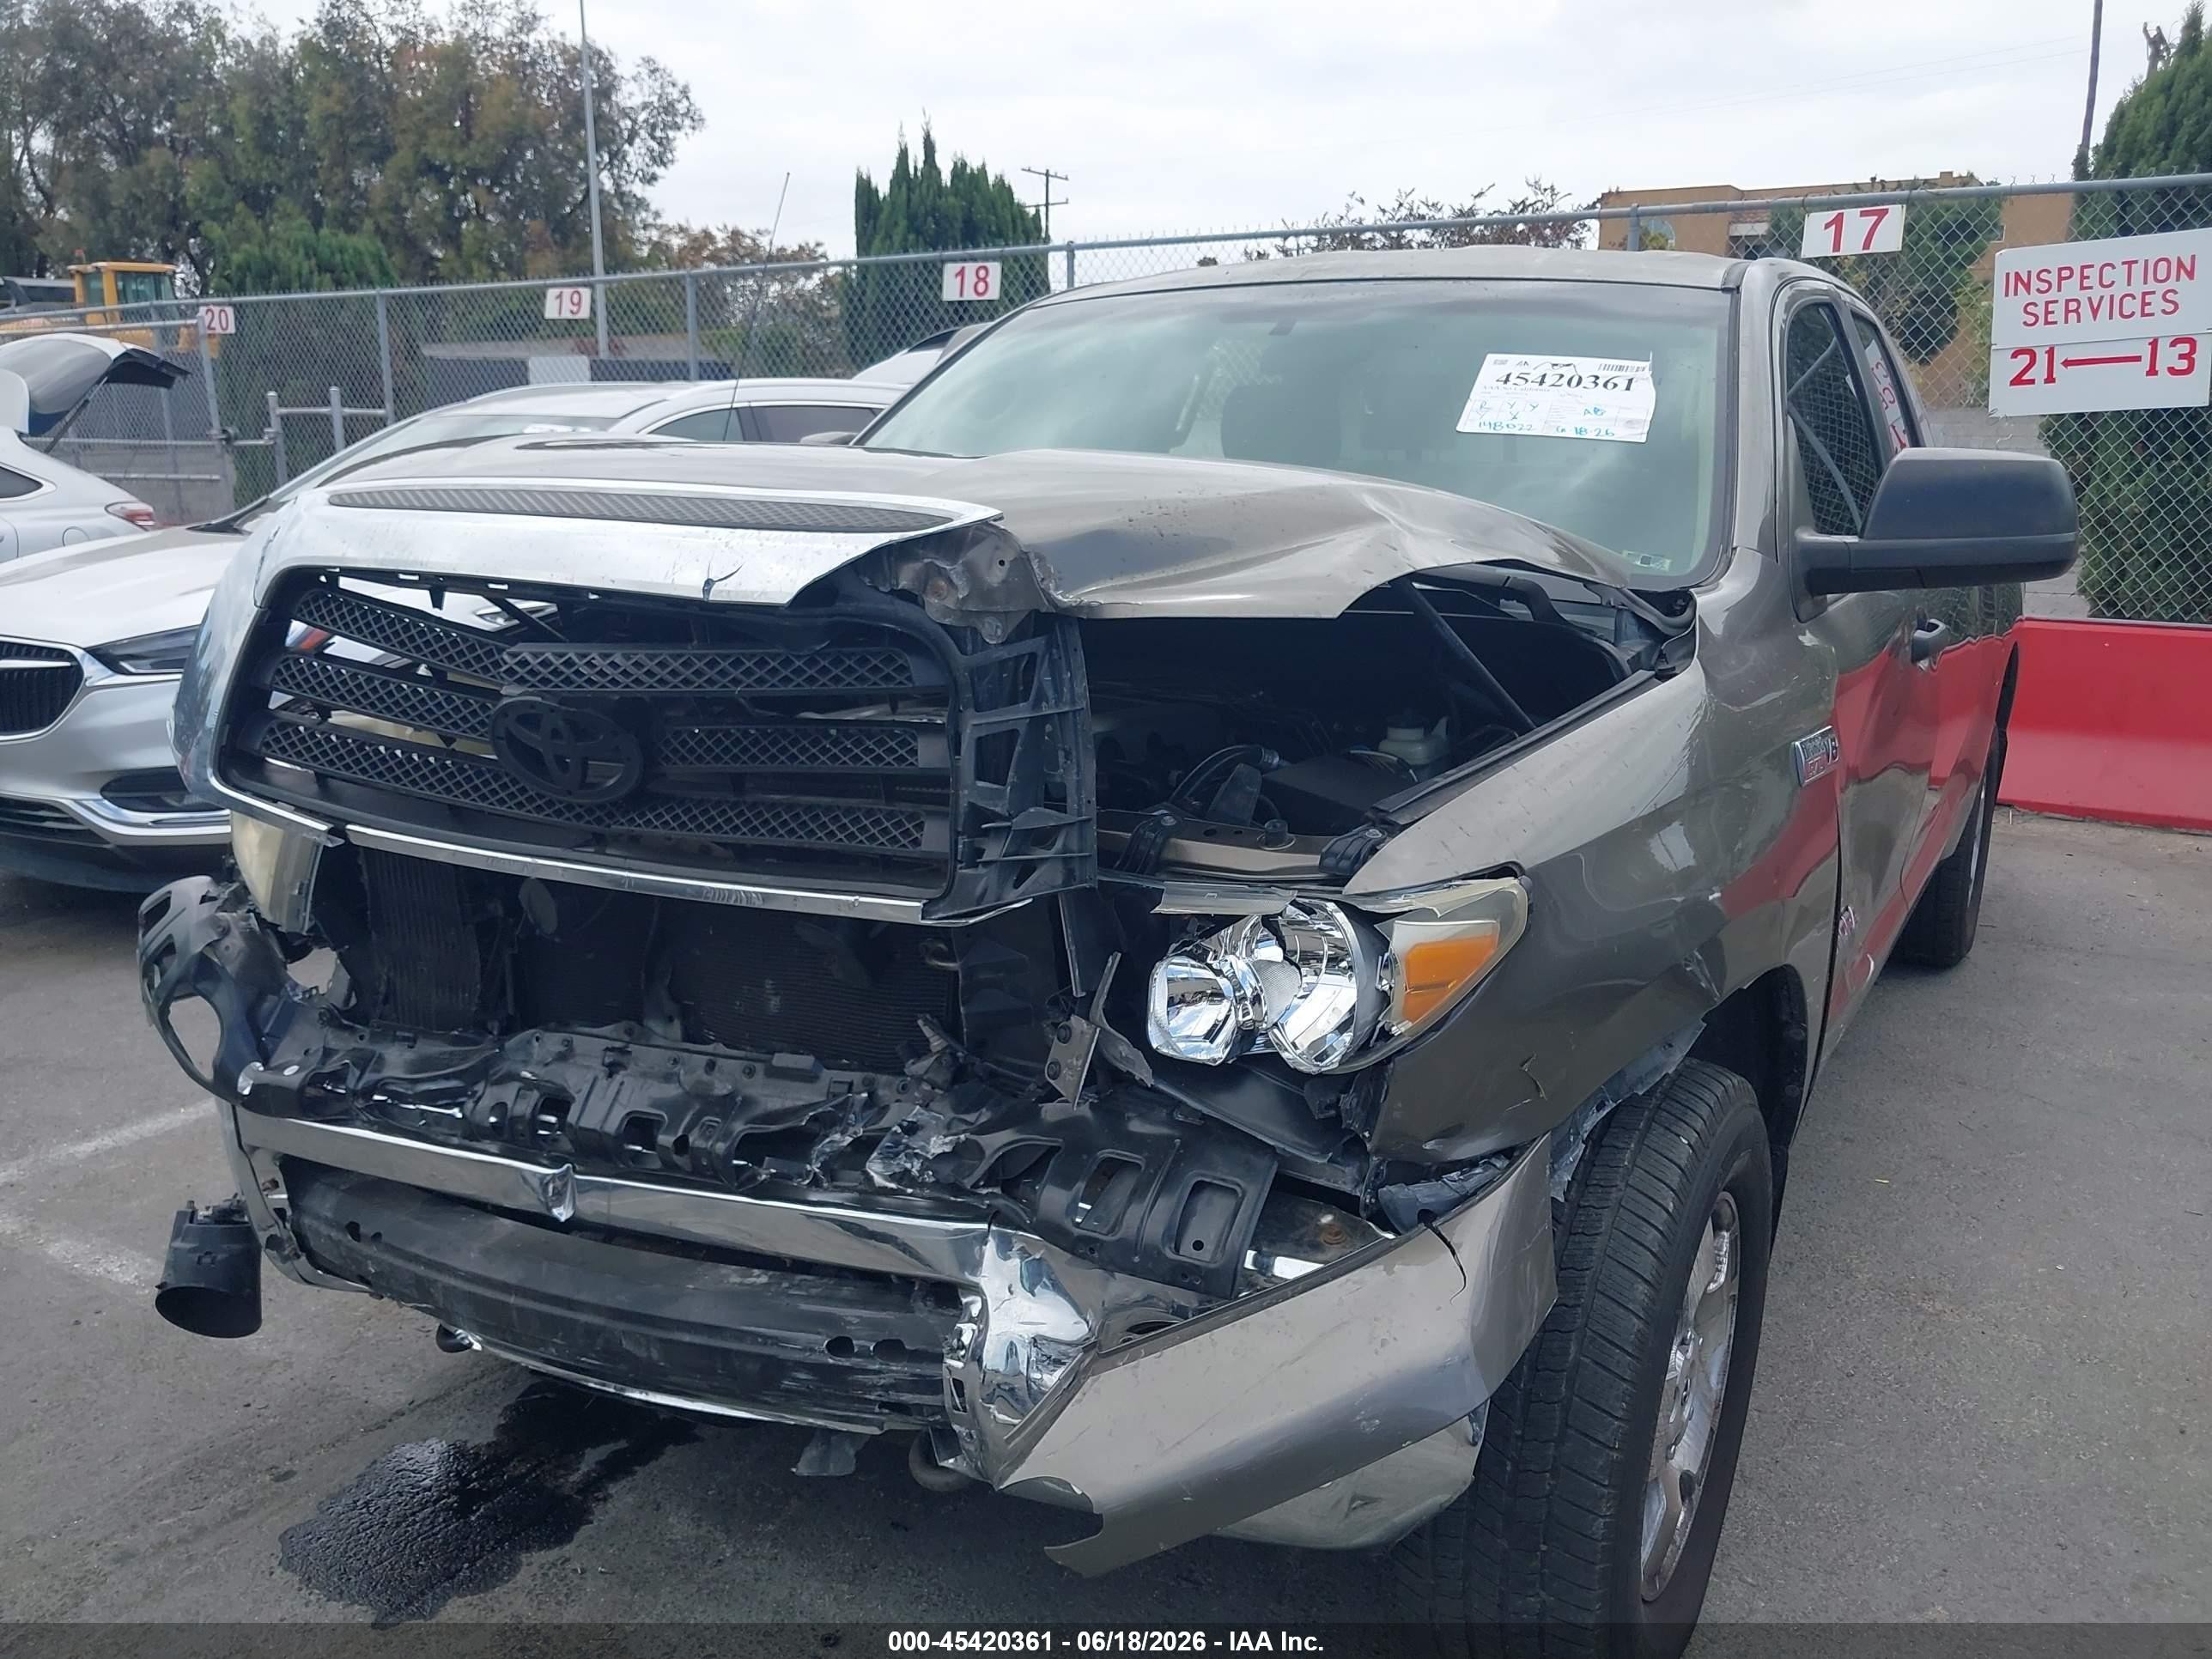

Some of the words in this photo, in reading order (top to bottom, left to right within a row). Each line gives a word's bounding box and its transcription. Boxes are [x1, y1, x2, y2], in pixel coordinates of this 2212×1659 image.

[1824, 208, 1890, 253] 17
[955, 264, 989, 298] 18
[2004, 254, 2197, 298] INSPECTION
[205, 307, 229, 331] 20
[555, 290, 581, 316] 19
[2022, 289, 2179, 327] SERVICES
[2009, 344, 2057, 386] 21
[2145, 337, 2197, 377] 13
[1495, 371, 1635, 392] 45420361
